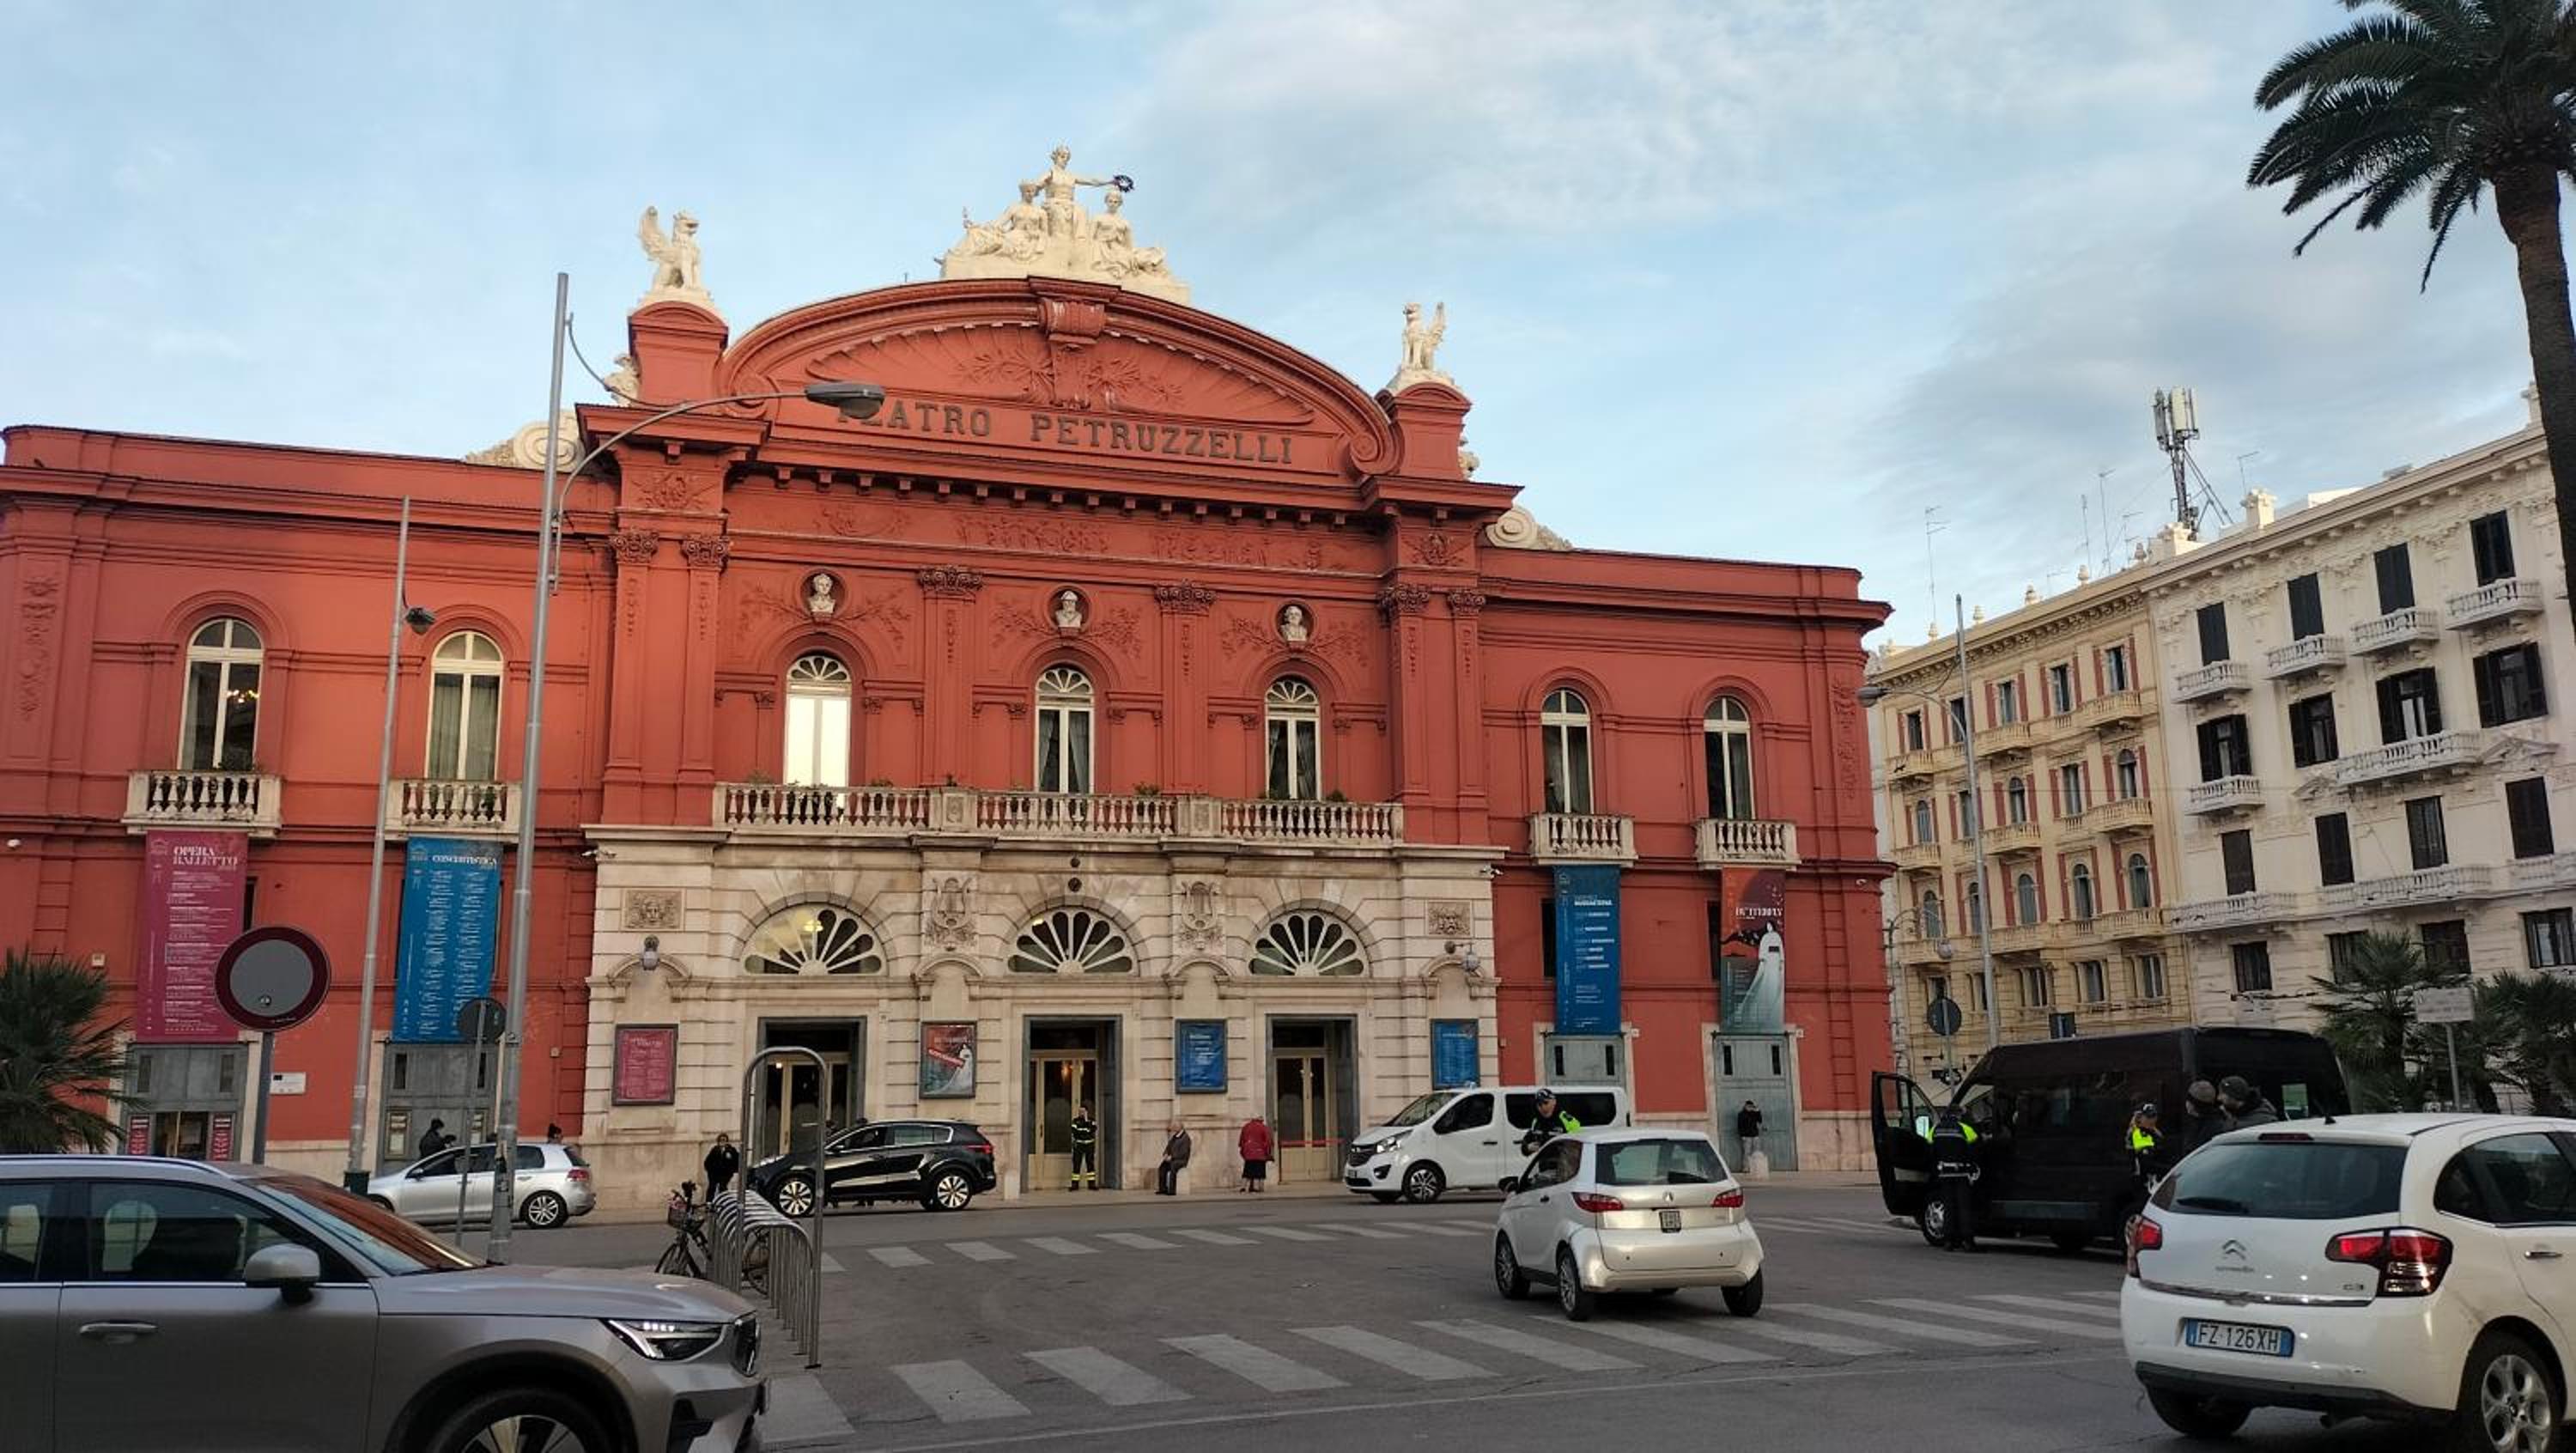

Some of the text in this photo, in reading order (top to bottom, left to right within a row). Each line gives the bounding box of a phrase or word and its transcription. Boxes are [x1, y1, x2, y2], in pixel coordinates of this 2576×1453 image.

[837, 398, 1292, 465] ATRO PETRUZZELLI
[2198, 1323, 2220, 1345] FZ
[2226, 1327, 2280, 1353] 126XH
